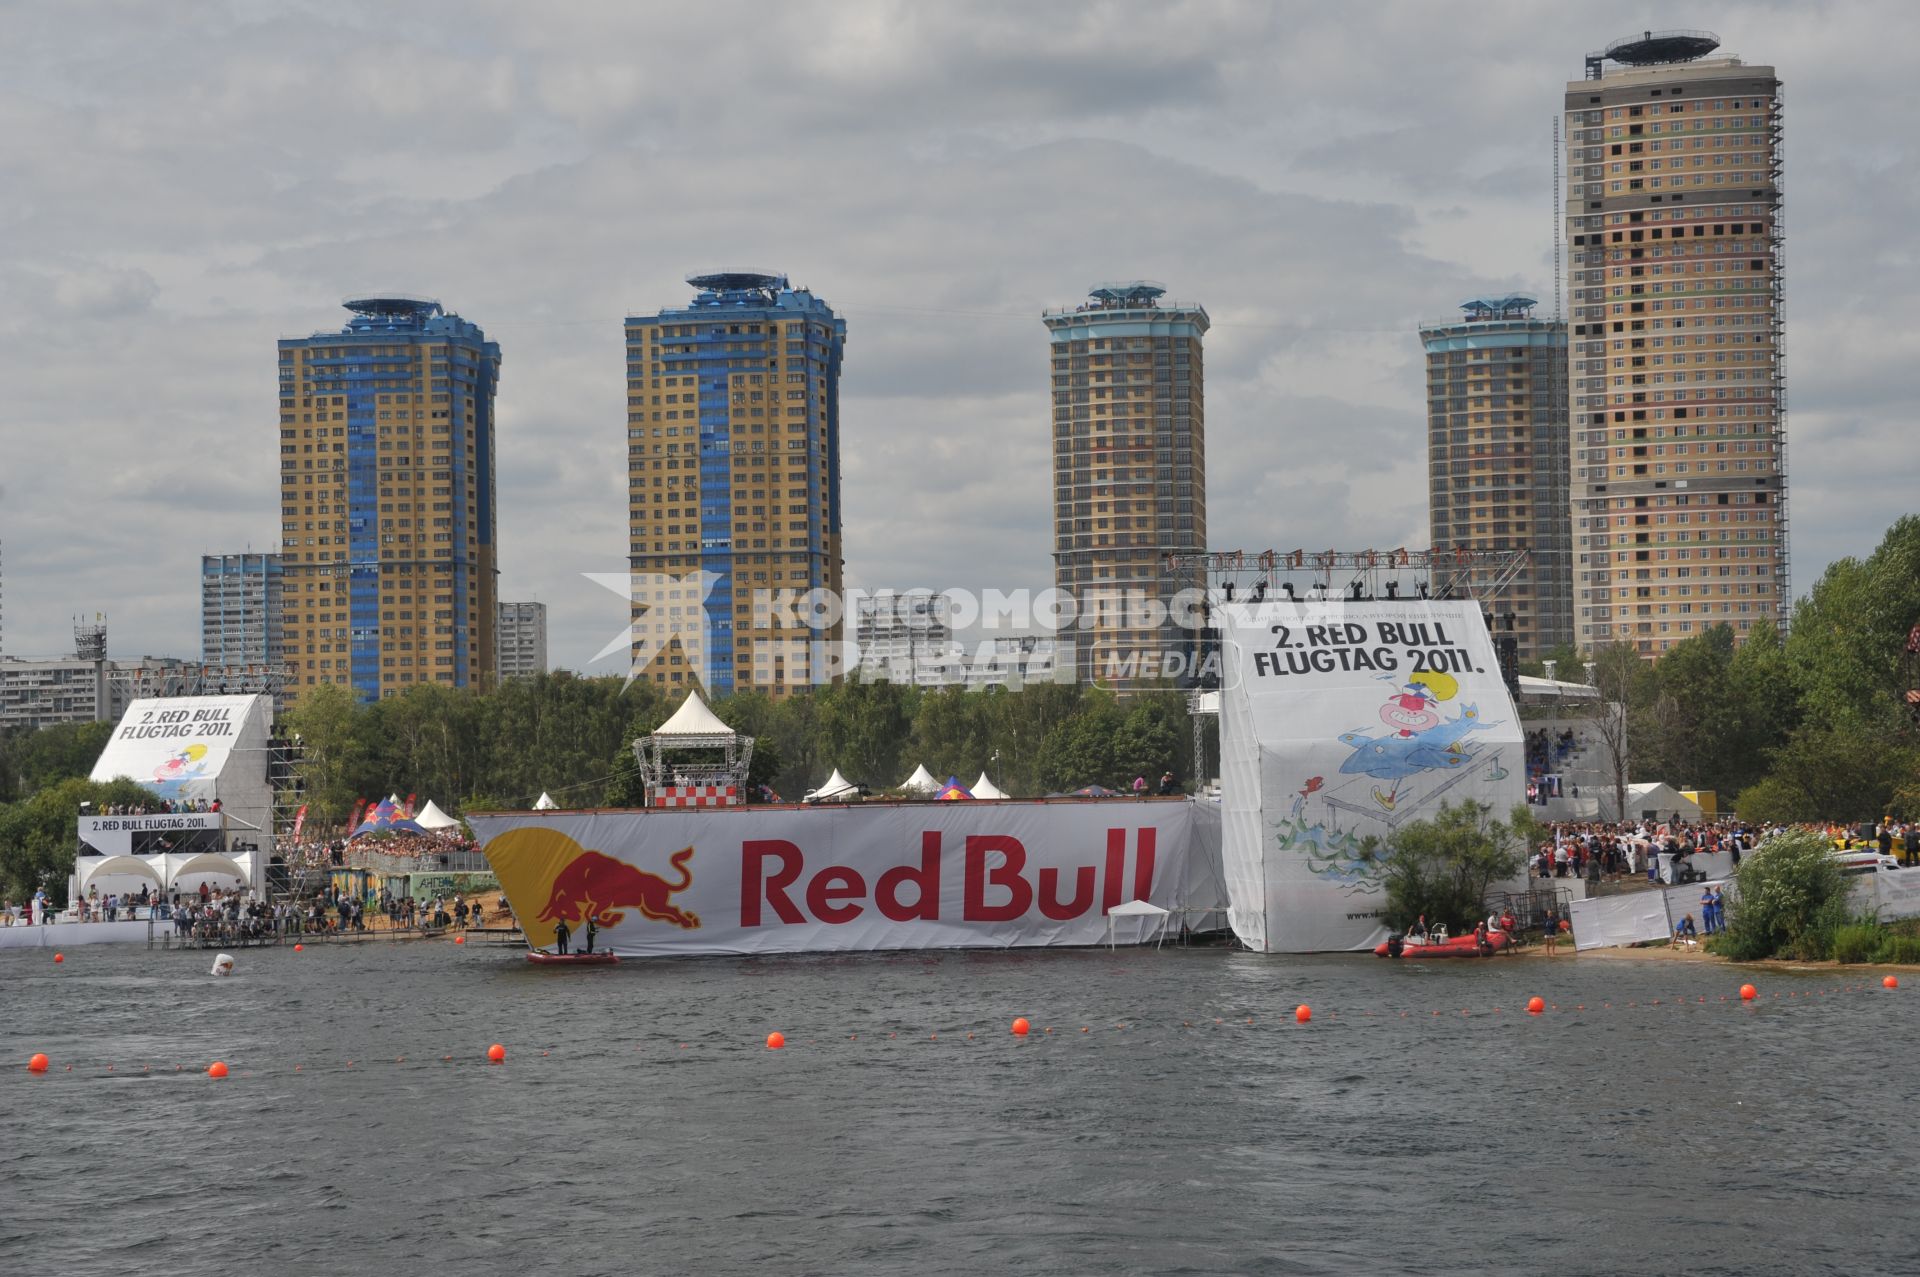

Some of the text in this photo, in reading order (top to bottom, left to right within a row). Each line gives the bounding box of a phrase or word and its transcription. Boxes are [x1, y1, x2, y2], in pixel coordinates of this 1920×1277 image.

[1271, 621, 1454, 649] 2. RED BULL
[1254, 647, 1485, 677] FLUGTAG 2011.
[140, 708, 230, 725] 2. RED BULL
[119, 722, 233, 739] FLUGTAG 2011.
[93, 817, 207, 831] 2. RED BULL FLUGTAG 2011.
[740, 827, 1157, 927] Red Bull
